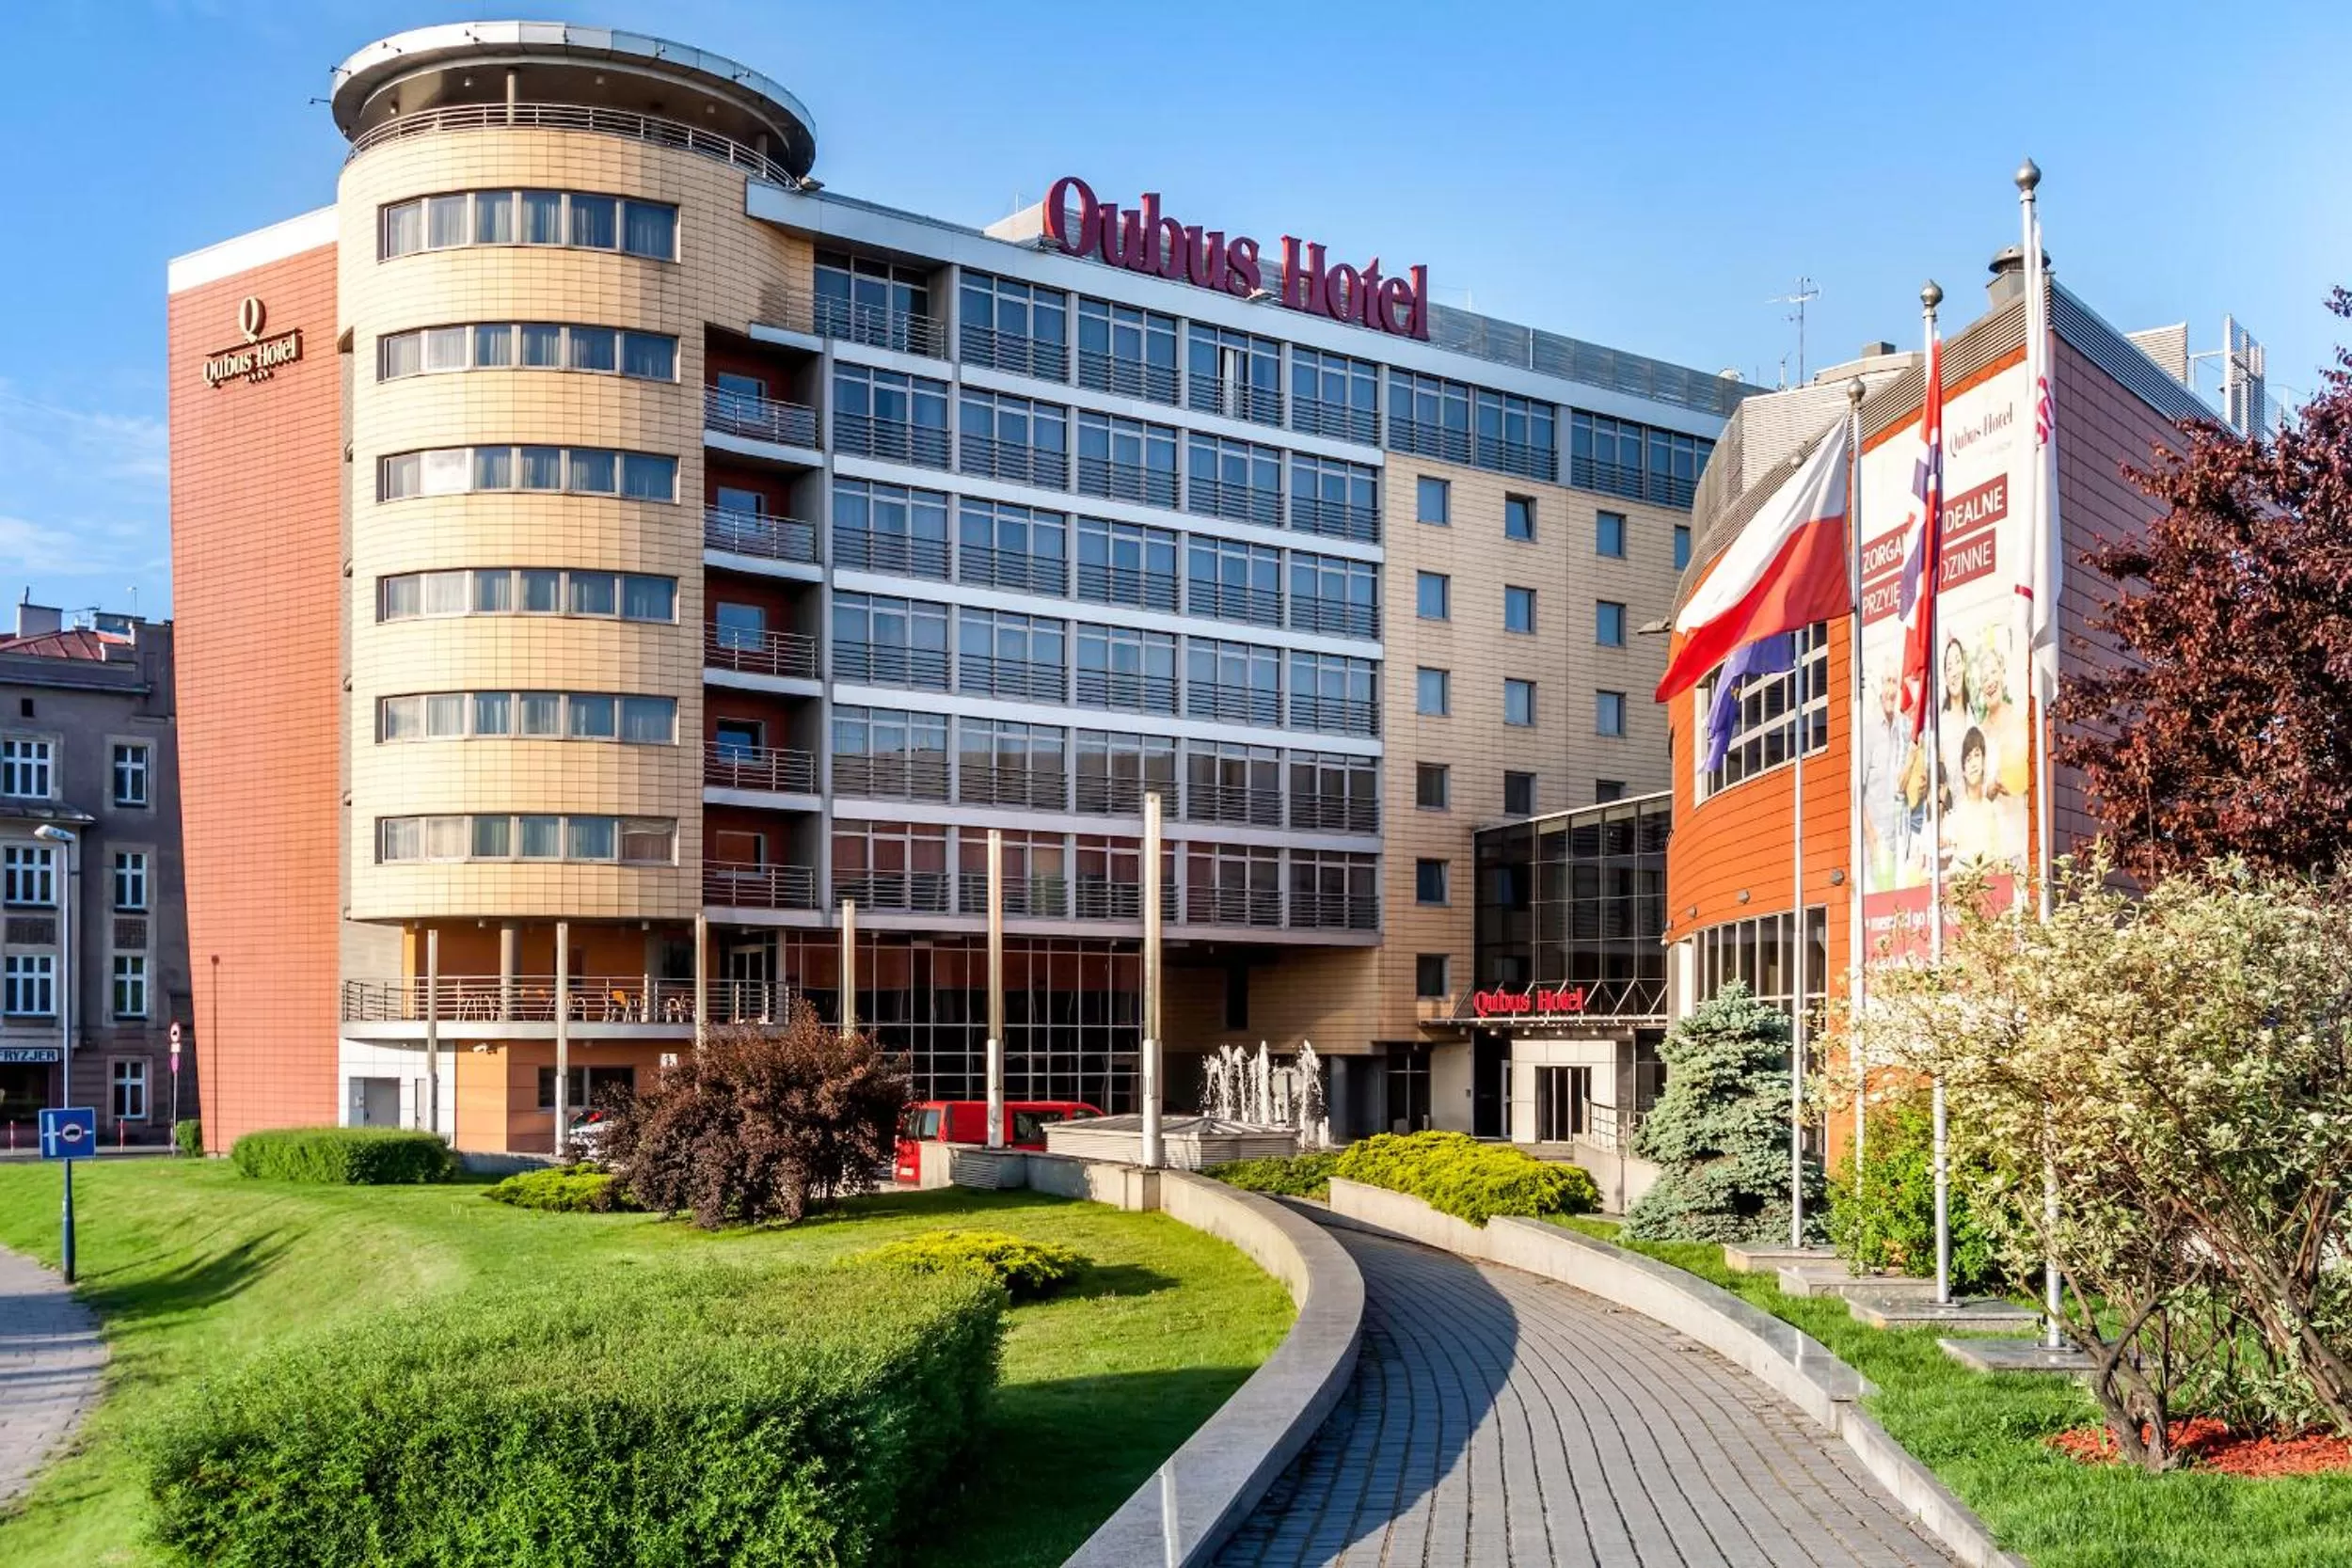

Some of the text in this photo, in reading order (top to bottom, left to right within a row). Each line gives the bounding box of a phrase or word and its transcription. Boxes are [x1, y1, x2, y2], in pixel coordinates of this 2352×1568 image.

[1043, 176, 1429, 341] Qubus Hotel
[239, 296, 262, 343] Q
[203, 332, 299, 388] Qubus Hotel
[1983, 401, 2013, 436] Hotel
[1863, 485, 2004, 574] ZORGA IDEALNE
[1863, 580, 1901, 618] PRZYJĘ
[1473, 988, 1582, 1017] Qubus Hotel
